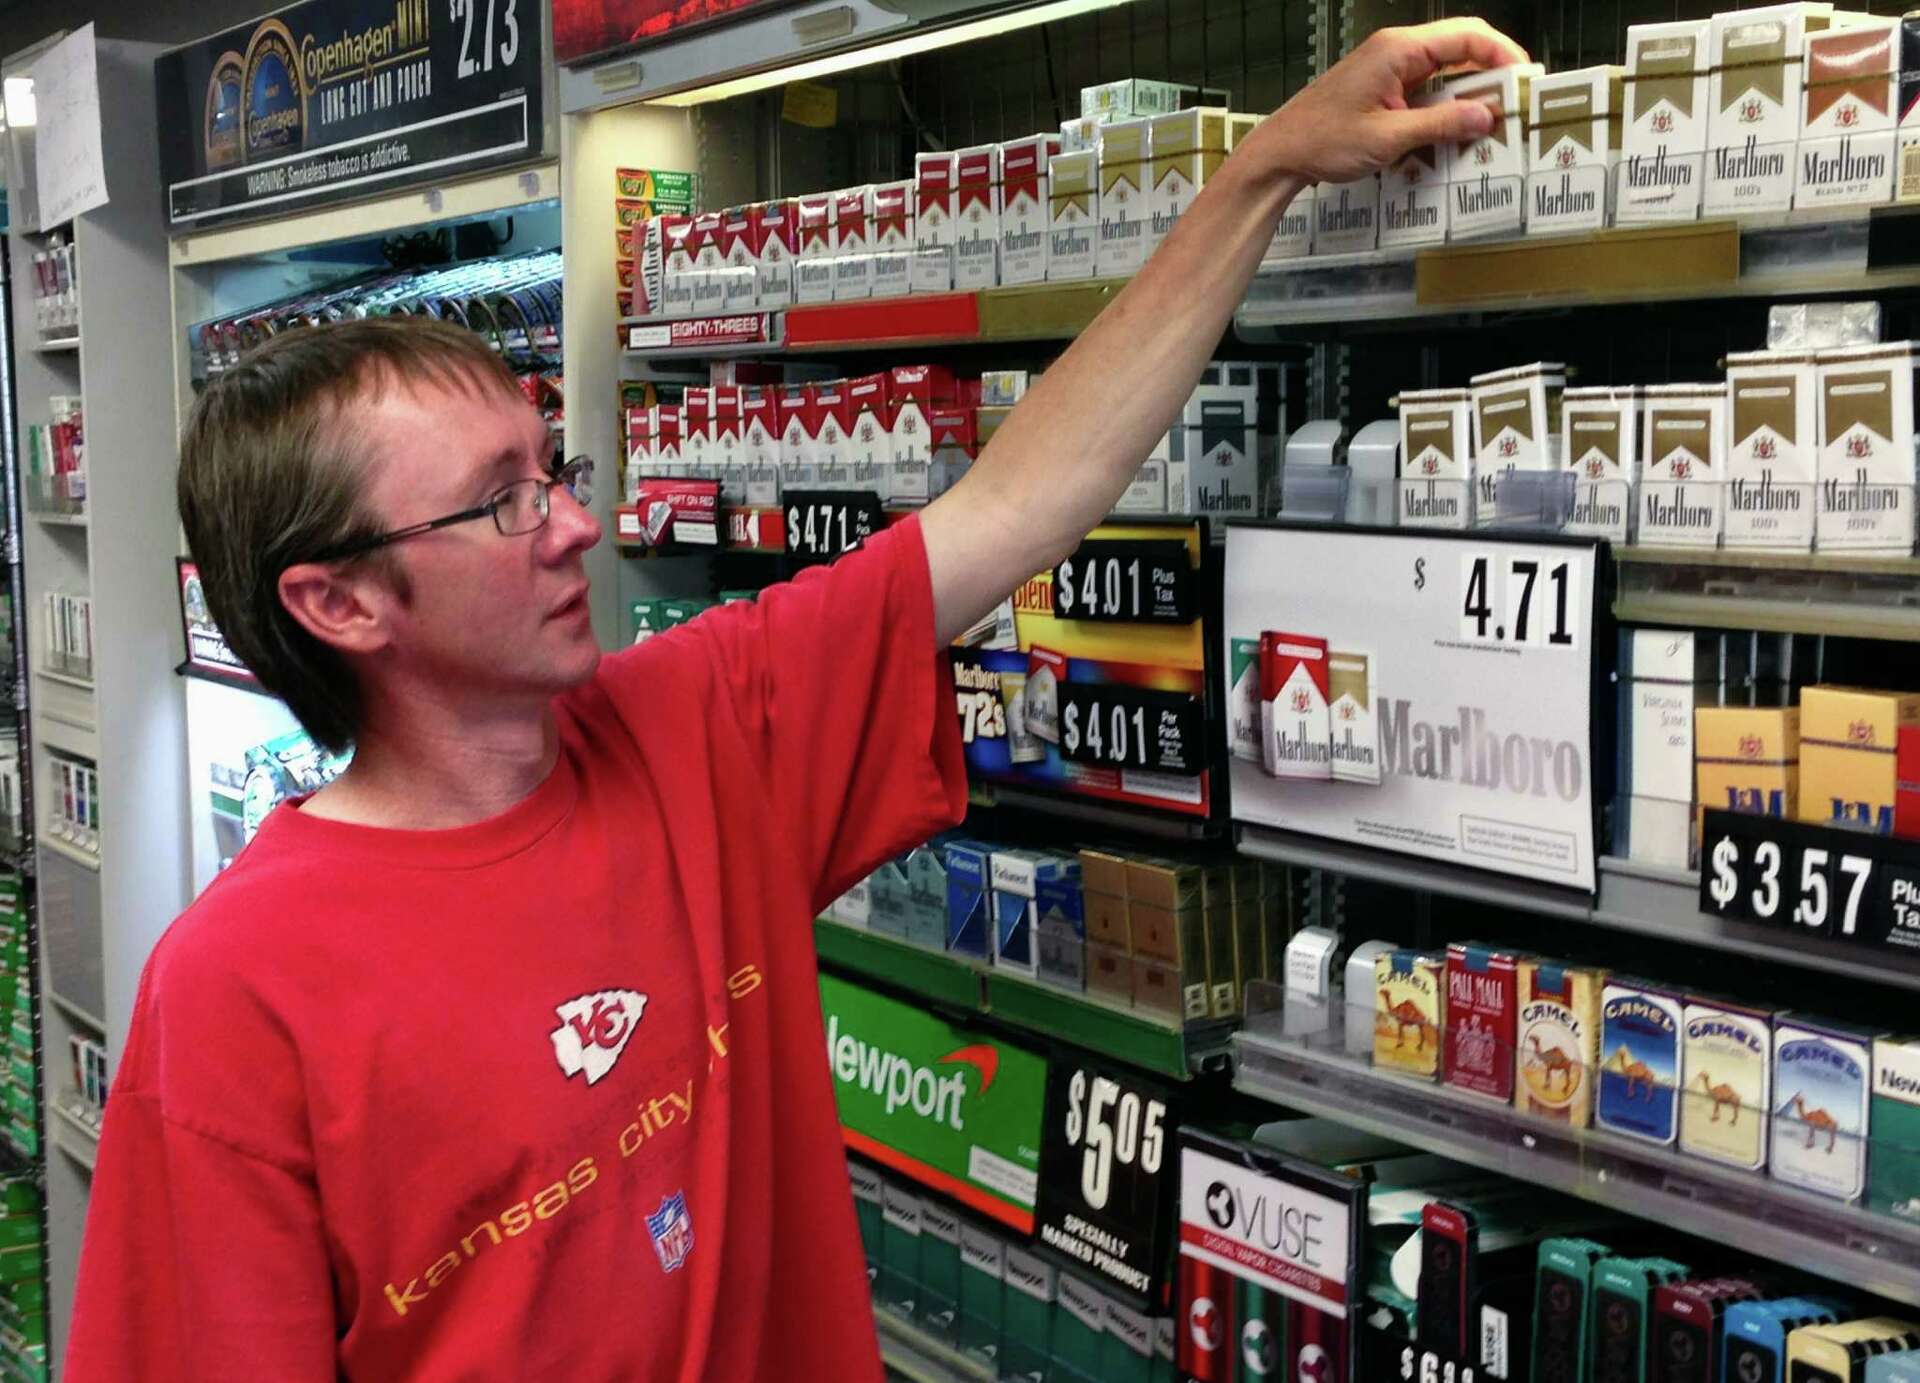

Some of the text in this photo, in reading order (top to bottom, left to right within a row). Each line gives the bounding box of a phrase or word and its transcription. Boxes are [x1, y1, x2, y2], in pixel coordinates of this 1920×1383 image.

[301, 24, 393, 96] Copenhagen
[320, 59, 432, 125] LONG CUT AND POUCH
[247, 140, 411, 195] WARNING: Smokeless tobacco is addictive.
[1628, 144, 1692, 188] Marlboro
[1714, 134, 1784, 180] Marlboro
[1803, 133, 1885, 185] Marlboro
[1456, 173, 1513, 216] Marlboro
[1535, 173, 1595, 217] Marlboro
[1405, 479, 1458, 518] Marlboro
[1646, 485, 1712, 528] Marlboro
[1729, 469, 1801, 512] Marlboro
[1823, 467, 1900, 513] Marlboro
[1152, 568, 1175, 585] Plus
[1154, 585, 1174, 602] Tax
[1413, 557, 1573, 645] $ 4.71
[1377, 697, 1583, 803] Marlboro
[1892, 902, 1920, 929] Ta
[1376, 970, 1432, 996] CAMEL
[1449, 970, 1473, 1003] PALL
[1475, 975, 1504, 1009] MALL
[1522, 1003, 1581, 1038] CAMEL
[1605, 1001, 1675, 1033] CAMEL
[1688, 1022, 1762, 1053] CAMEL
[1781, 1046, 1861, 1081] CAMEL
[383, 1079, 694, 1317] kansas city
[1064, 1213, 1130, 1258] SPECIALLY
[1236, 1187, 1323, 1268] VUSE
[1041, 1223, 1151, 1293] MARKED PRODUCT
